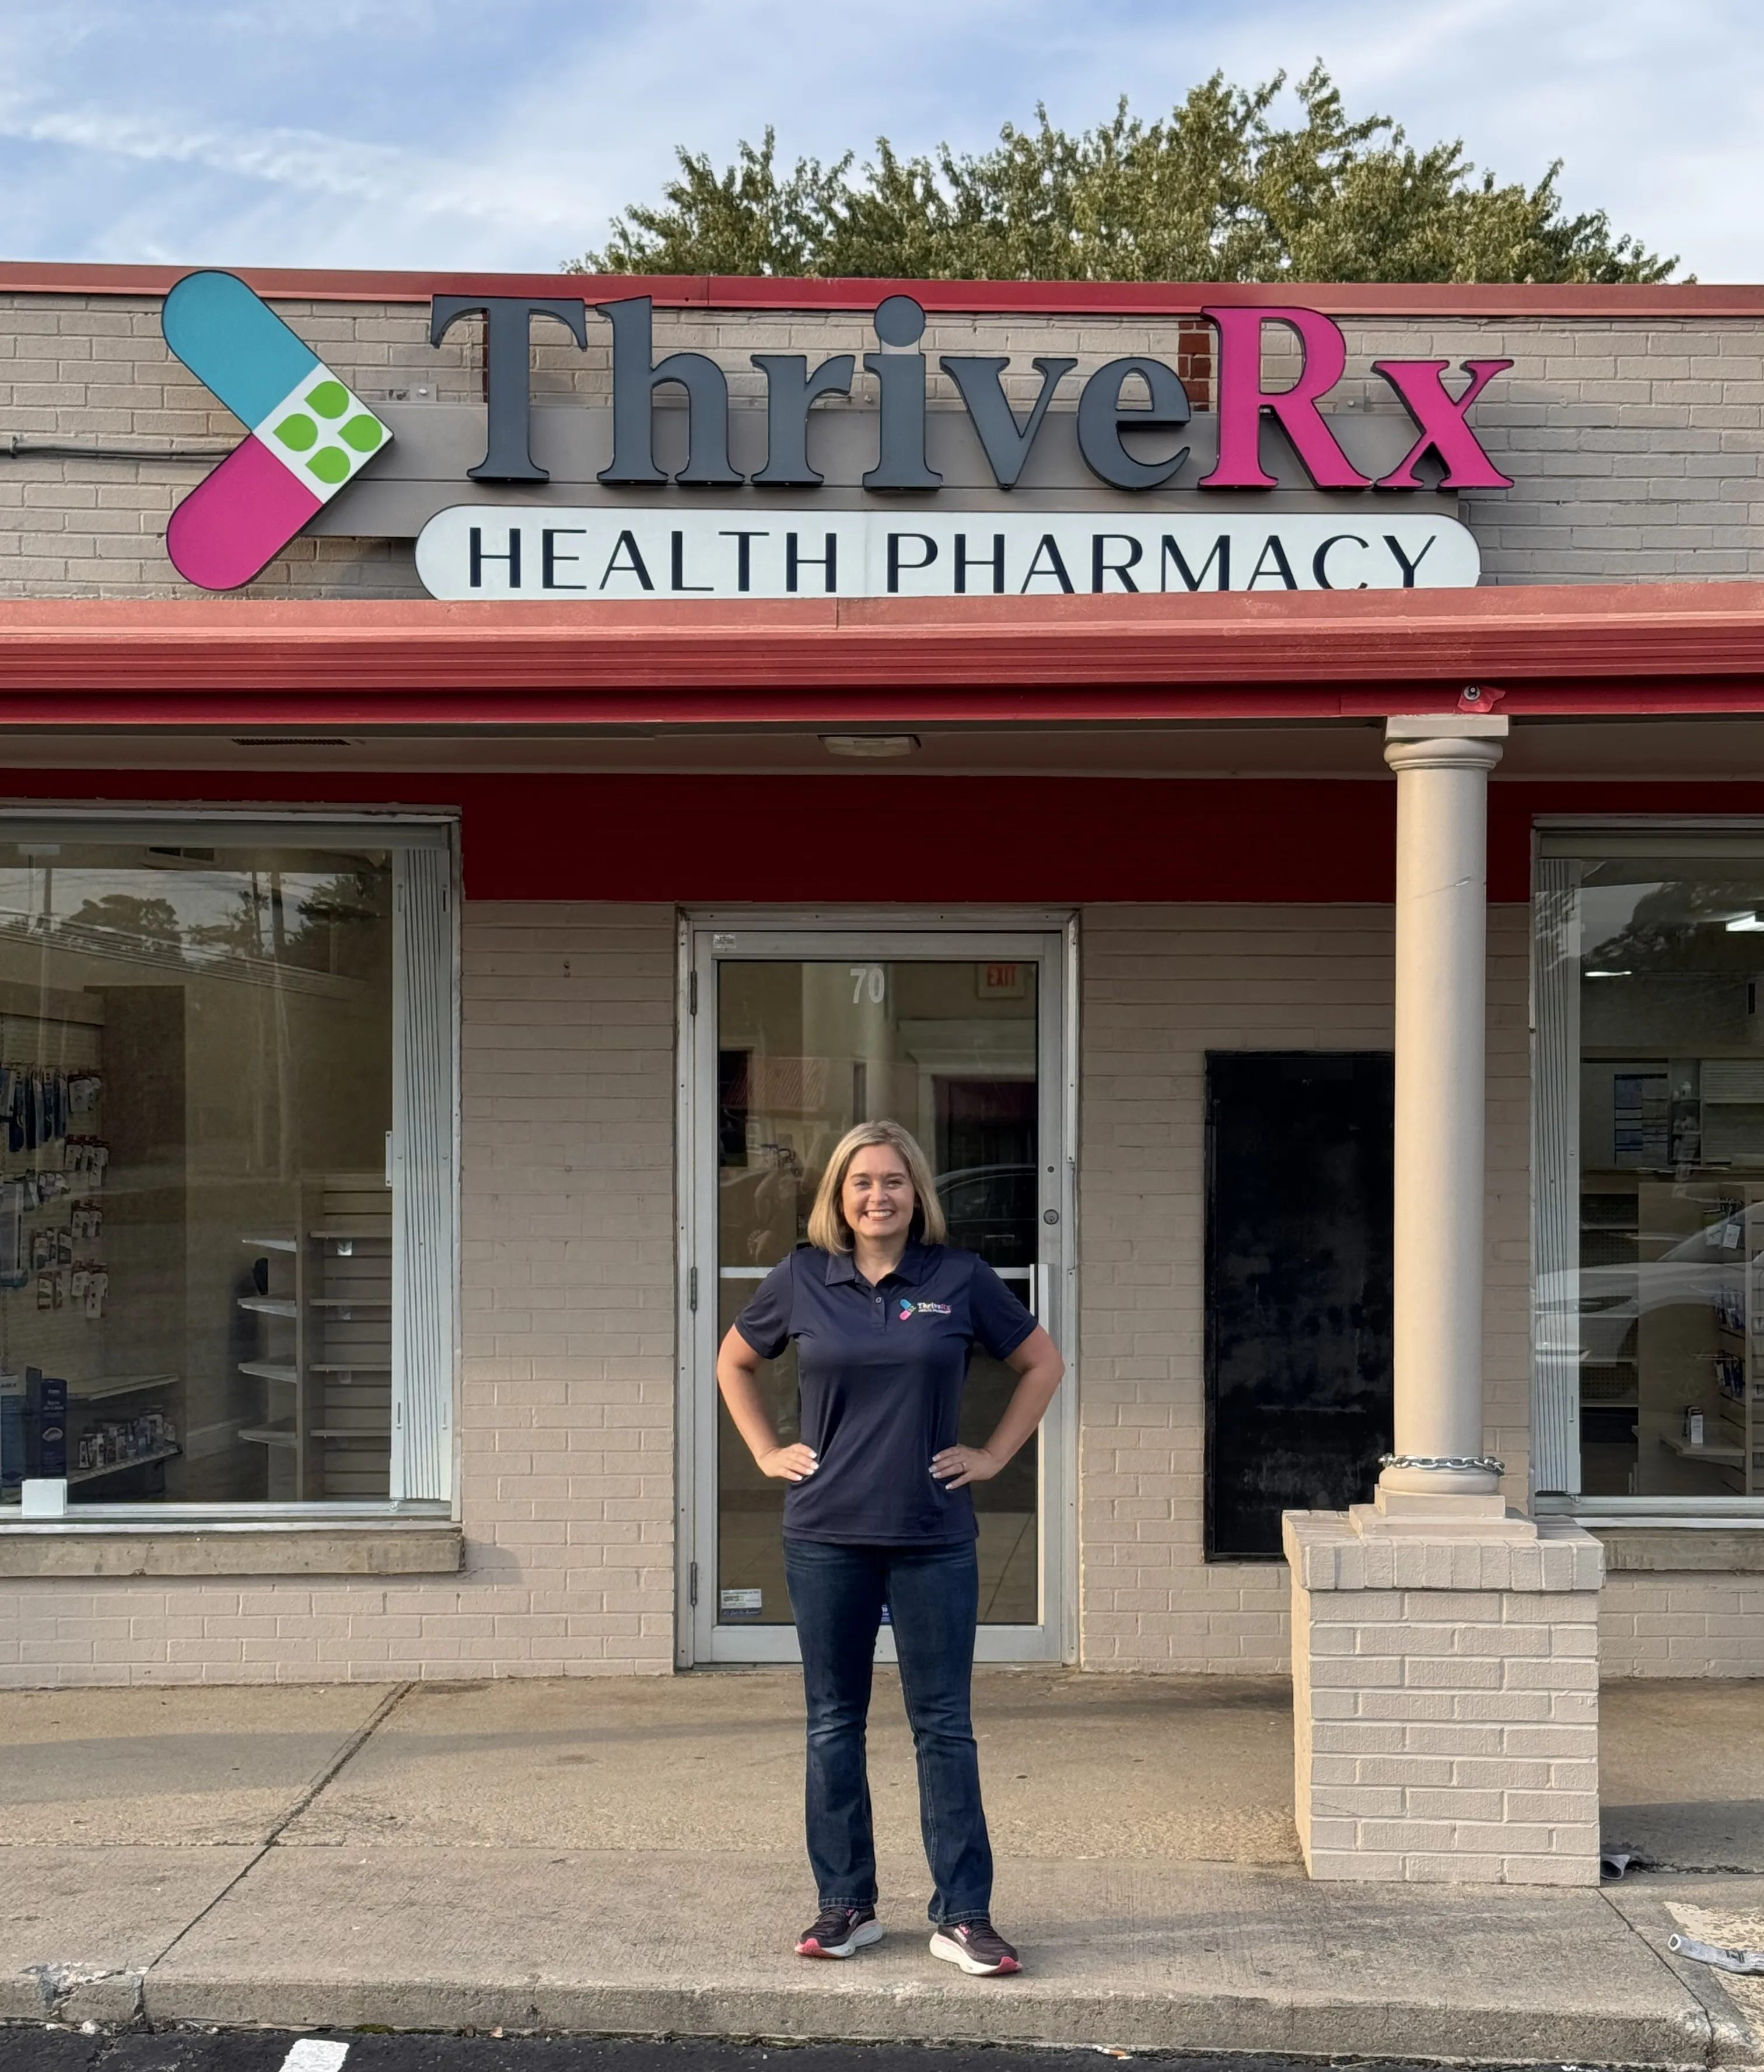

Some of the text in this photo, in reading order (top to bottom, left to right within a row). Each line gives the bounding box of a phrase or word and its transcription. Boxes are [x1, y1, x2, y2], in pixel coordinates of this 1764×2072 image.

[430, 295, 1516, 491] ThriveRx
[470, 527, 1437, 594] HEALTH PHARMACY
[849, 968, 884, 1004] 70
[986, 965, 1017, 987] EXIT
